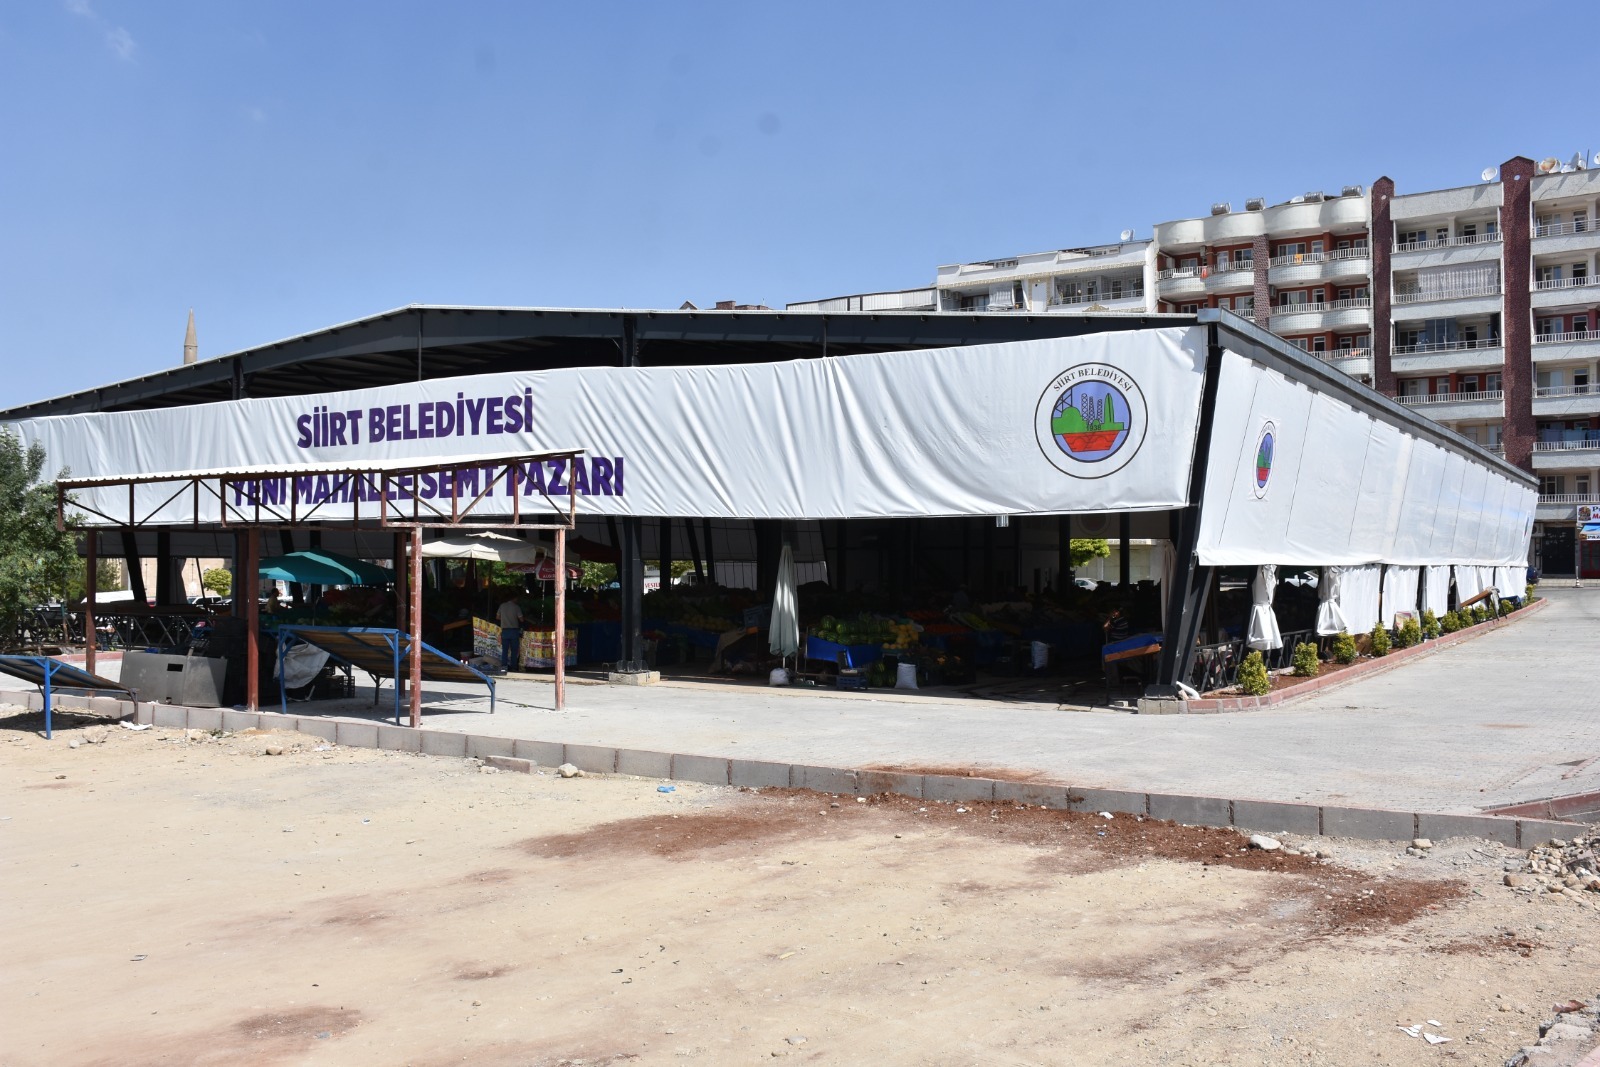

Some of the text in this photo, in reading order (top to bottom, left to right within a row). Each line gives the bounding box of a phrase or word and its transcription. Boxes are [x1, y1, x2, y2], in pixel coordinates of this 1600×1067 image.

[1053, 368, 1133, 392] SİİRT BELEDİYESİ
[297, 387, 533, 449] SİİRT BELEDİYESİ
[419, 465, 499, 500] SEMT
[506, 456, 624, 497] PAZARI
